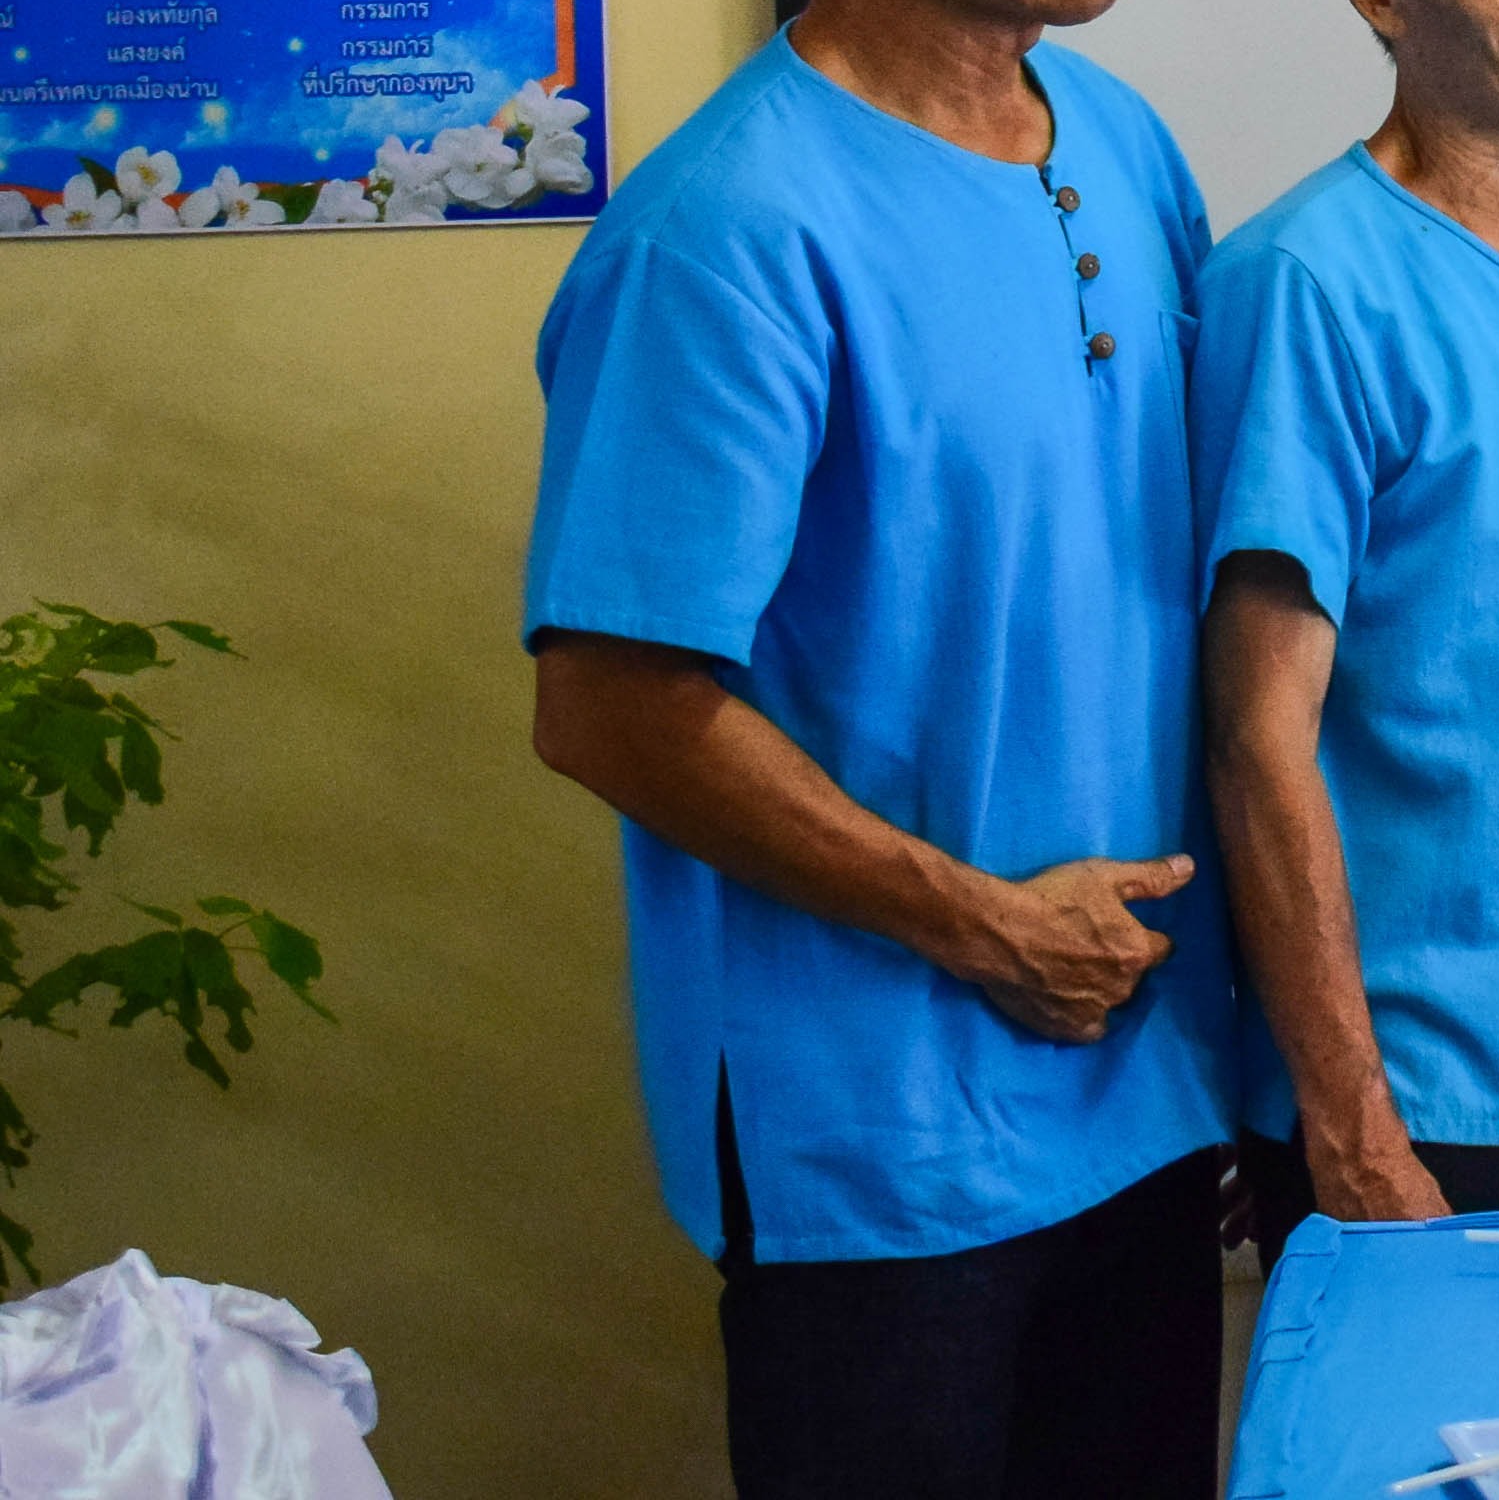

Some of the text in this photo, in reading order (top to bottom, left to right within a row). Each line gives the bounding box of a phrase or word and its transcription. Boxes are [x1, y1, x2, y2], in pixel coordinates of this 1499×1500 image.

[341, 2, 430, 20] กรรมการ
[342, 38, 431, 56] กรรมการ
[303, 64, 473, 100] ที่ปรึกษากองทุนฯ
